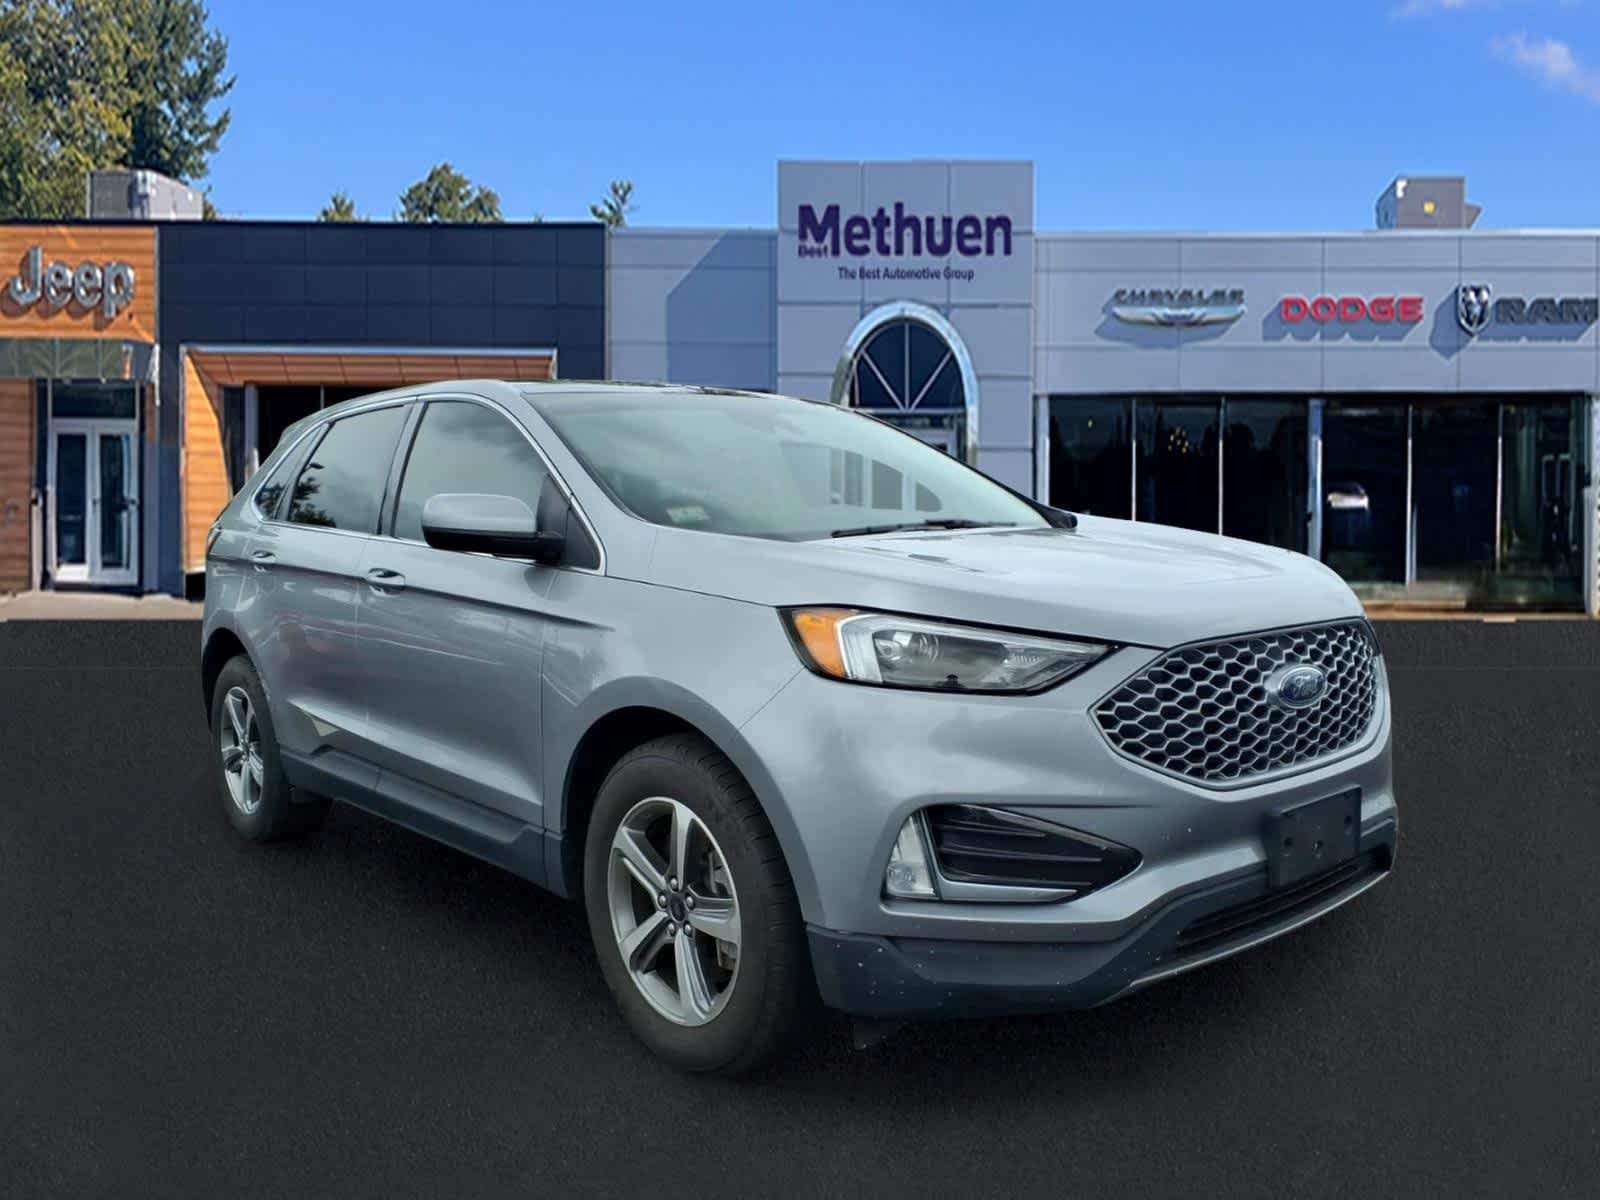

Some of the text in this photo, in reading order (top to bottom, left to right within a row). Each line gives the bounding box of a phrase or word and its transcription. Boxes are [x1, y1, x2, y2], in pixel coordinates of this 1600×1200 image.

[798, 202, 1012, 257] Methuen
[9, 245, 135, 319] Jeep
[837, 266, 974, 283] The Best Automotive Group
[1114, 287, 1245, 304] CHRYSLER
[1280, 296, 1424, 322] DODGE
[1495, 298, 1599, 324] RAM
